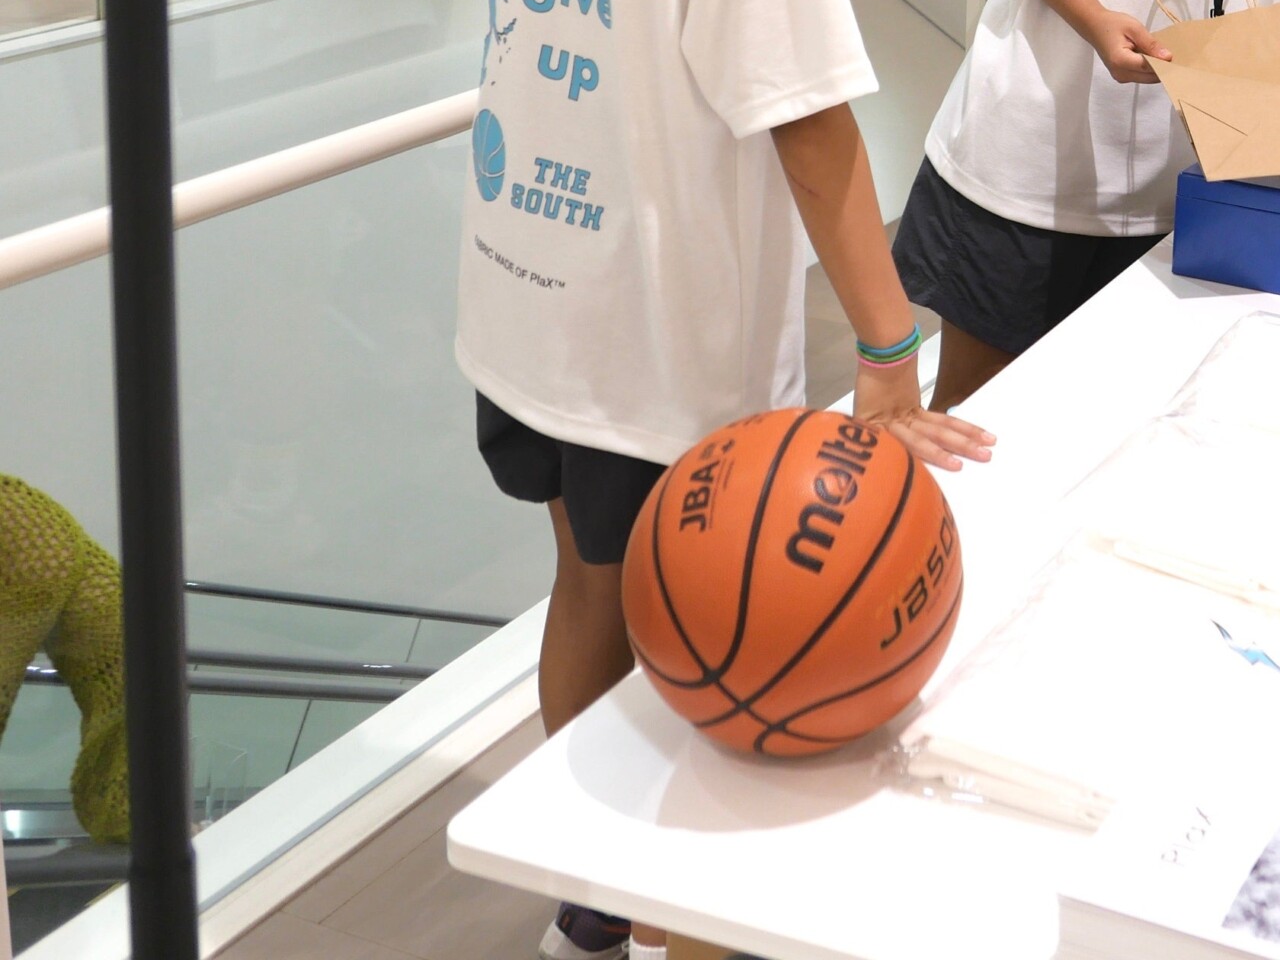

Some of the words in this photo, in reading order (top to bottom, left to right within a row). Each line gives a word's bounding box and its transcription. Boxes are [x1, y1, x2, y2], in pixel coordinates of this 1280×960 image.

[537, 43, 600, 102] up
[534, 156, 592, 196] THE
[510, 182, 605, 232] SOUTH
[494, 252, 515, 274] MADE
[515, 266, 528, 279] OF
[679, 460, 721, 532] JBA
[785, 418, 879, 575] molte
